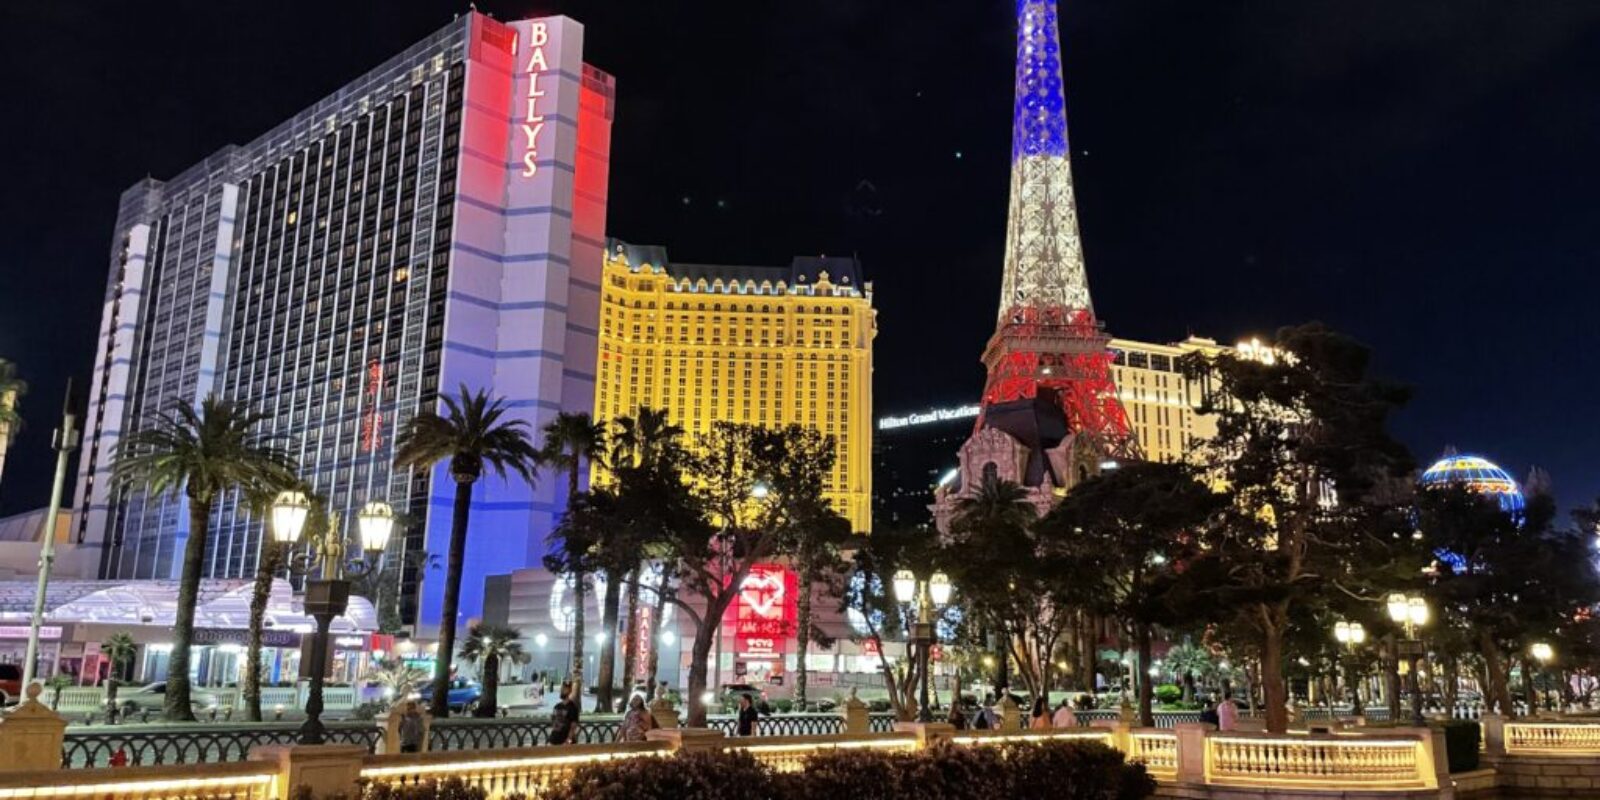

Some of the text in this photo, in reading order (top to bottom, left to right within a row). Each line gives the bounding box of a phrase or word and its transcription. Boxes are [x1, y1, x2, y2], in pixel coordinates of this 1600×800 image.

[522, 22, 548, 178] BALLYS
[879, 416, 909, 430] Hilton
[909, 410, 937, 424] Grand
[639, 606, 649, 674] BALLYS
